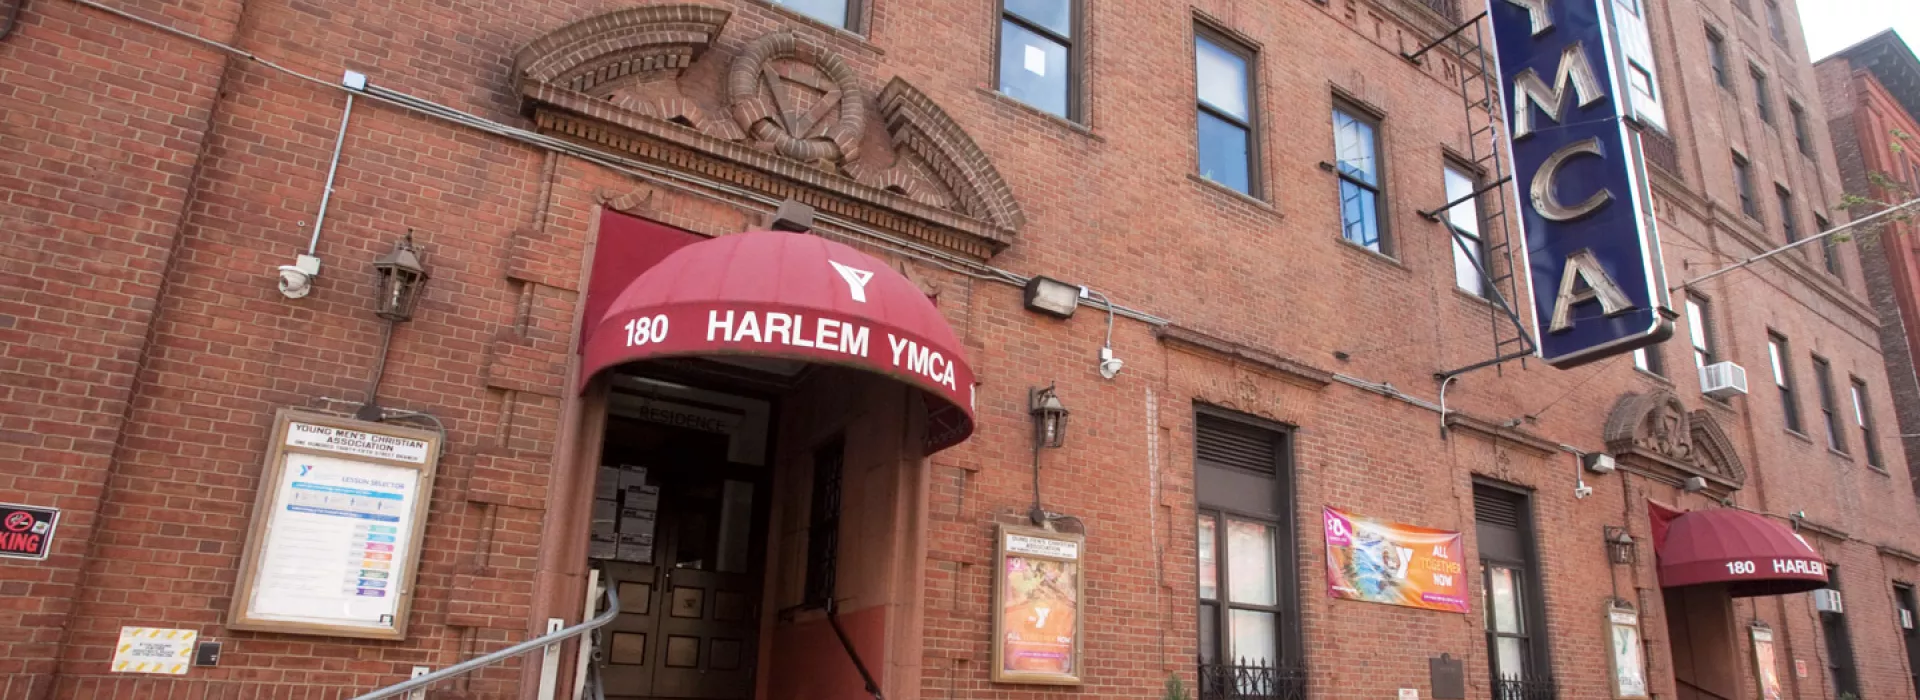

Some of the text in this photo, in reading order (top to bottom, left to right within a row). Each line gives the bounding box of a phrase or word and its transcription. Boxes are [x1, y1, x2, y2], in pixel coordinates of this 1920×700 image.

[624, 314, 669, 347] 180
[706, 310, 870, 358] HARLEM
[887, 332, 956, 391] YMCA
[639, 404, 727, 432] RESIDENCE
[296, 424, 332, 435] YOUNG
[371, 435, 424, 449] CHRISTIAN
[327, 436, 394, 452] ASSOCIATION
[1432, 545, 1448, 559] ALL
[1725, 560, 1756, 575] 180
[1432, 573, 1453, 587] NOW
